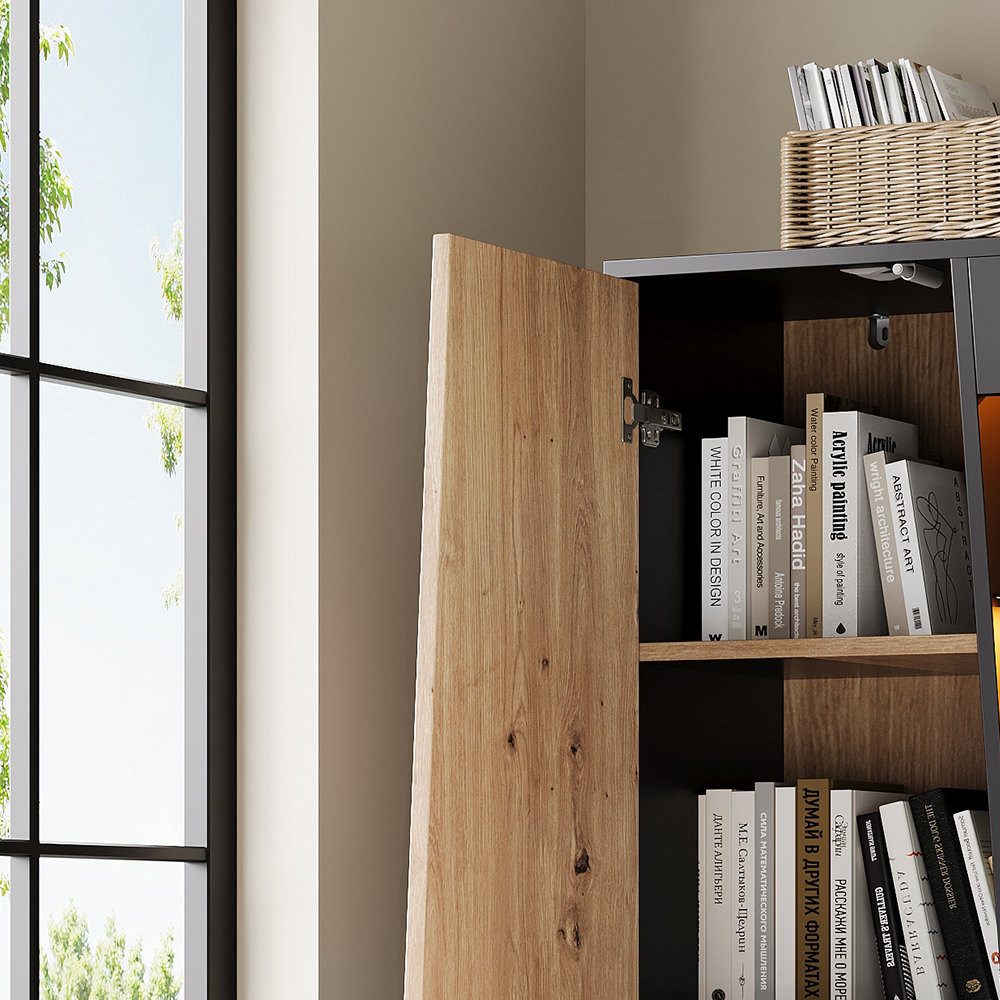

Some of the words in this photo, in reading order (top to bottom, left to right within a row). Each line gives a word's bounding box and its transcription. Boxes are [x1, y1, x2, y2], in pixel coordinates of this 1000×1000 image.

[810, 408, 819, 432] Water
[810, 435, 819, 455] color
[830, 430, 848, 477] Acrylic
[710, 446, 722, 488] WHITE
[731, 445, 743, 523] Graffiti
[792, 458, 805, 507] Zaha
[809, 458, 819, 492] Painting
[869, 461, 884, 503] wright
[710, 491, 722, 538] COLOR
[756, 475, 765, 512] Furniture,
[829, 482, 848, 541] painting
[756, 512, 765, 524] Art
[756, 525, 765, 541] and
[892, 475, 910, 544] ABSTRACT
[903, 548, 915, 574] ART
[710, 542, 722, 554] IN
[731, 532, 743, 565] Art
[792, 514, 805, 570] Hadid
[834, 552, 845, 568] style
[876, 505, 896, 583] architecture
[710, 558, 722, 607] DESIGN
[756, 542, 765, 588] Accessories
[774, 572, 785, 599] Antoine
[834, 578, 845, 605] painting
[755, 625, 768, 636] M
[774, 600, 785, 629] Predock
[712, 813, 723, 848] ДАНТЕ
[738, 822, 748, 846] М.Е.
[759, 812, 768, 839] СИЛА
[803, 787, 823, 840] ДУМАЙ
[804, 844, 819, 854] В
[713, 850, 723, 905] АЛИГЬЕРИ
[759, 841, 768, 932] МАТЕМАТИЧЕСКОГО
[803, 858, 820, 916] ДРУГИХ
[736, 848, 749, 953] Салтыков-Щедрин
[834, 879, 847, 934] РАССКАЖИ
[759, 934, 768, 990] МЫШЛЕНИЯ
[804, 920, 820, 999] ФОРМАТАХ
[834, 937, 847, 959] МНЕ
[834, 972, 847, 1000] МОРЕ
